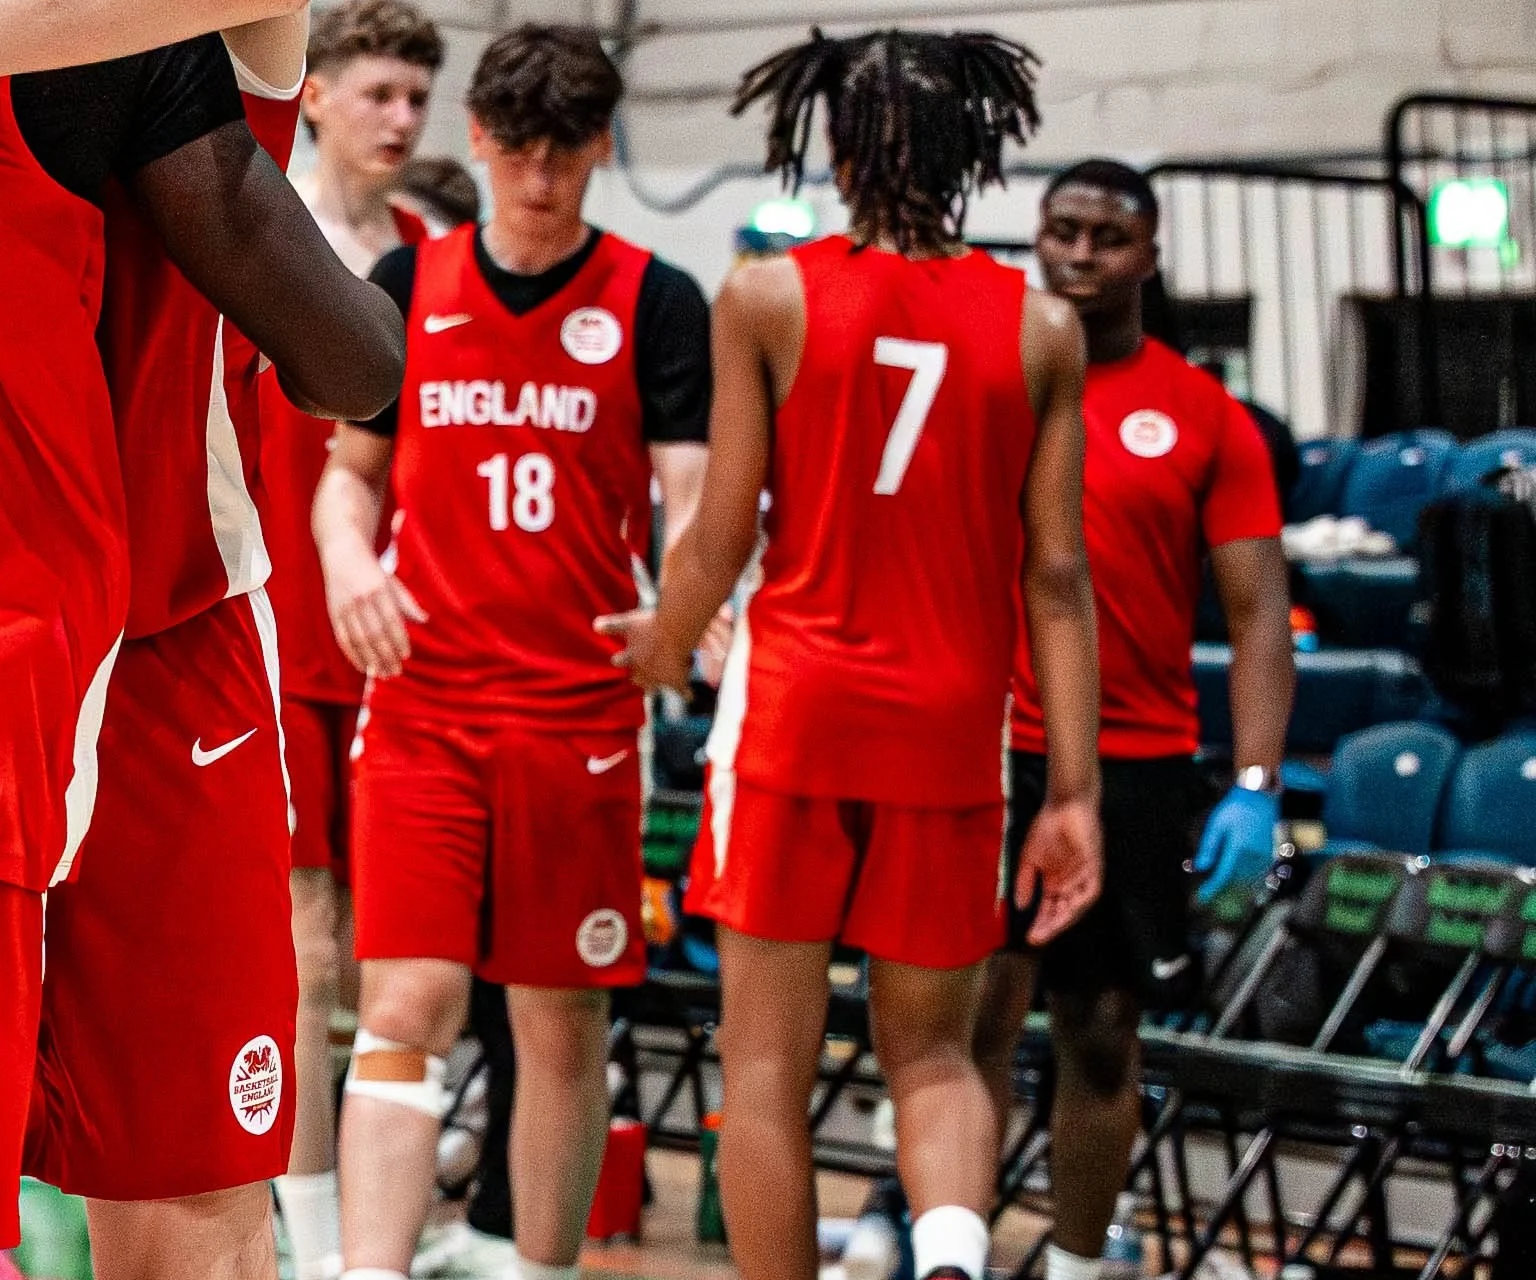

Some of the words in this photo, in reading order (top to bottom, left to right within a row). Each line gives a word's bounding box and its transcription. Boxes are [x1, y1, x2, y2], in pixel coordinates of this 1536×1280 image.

[419, 379, 597, 433] ENGLAND
[873, 336, 949, 496] 7
[477, 452, 556, 533] 18
